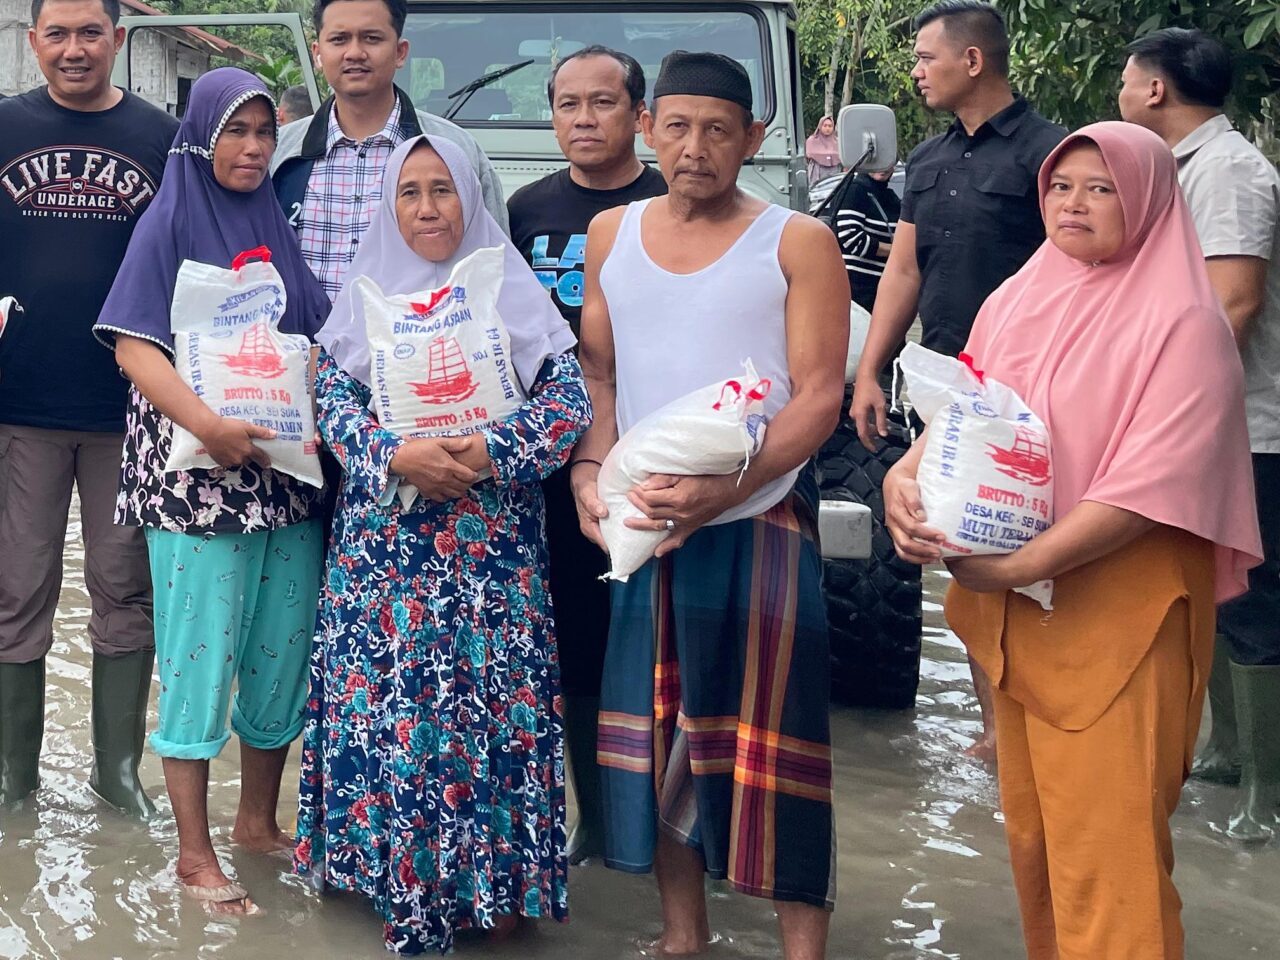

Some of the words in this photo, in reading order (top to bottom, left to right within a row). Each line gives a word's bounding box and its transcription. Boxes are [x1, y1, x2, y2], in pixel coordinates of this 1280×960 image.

[0, 152, 71, 201] LIVE
[80, 152, 154, 207] FAST
[37, 192, 116, 208] UNDERAGE
[106, 214, 127, 222] ROCK
[393, 319, 441, 334] BINTANG
[486, 327, 500, 340] 64
[493, 343, 504, 357] IR
[495, 360, 514, 400] BERAS
[223, 387, 263, 400] BRUTTO
[270, 389, 278, 400] 5
[280, 390, 291, 405] Kg
[220, 406, 241, 417] DESA
[243, 406, 260, 416] KEC
[266, 407, 279, 416] SEI
[281, 407, 301, 418] SUKA
[415, 414, 458, 428] BRUTTO
[464, 410, 472, 421] 5
[473, 407, 488, 420] Kg
[475, 420, 498, 432] SUKA
[977, 484, 1025, 507] BRUTTO
[1031, 498, 1039, 511] 5
[965, 502, 993, 519] DESA
[995, 510, 1015, 523] KEC
[1021, 516, 1035, 528] SEI
[959, 516, 1000, 538] MUTU
